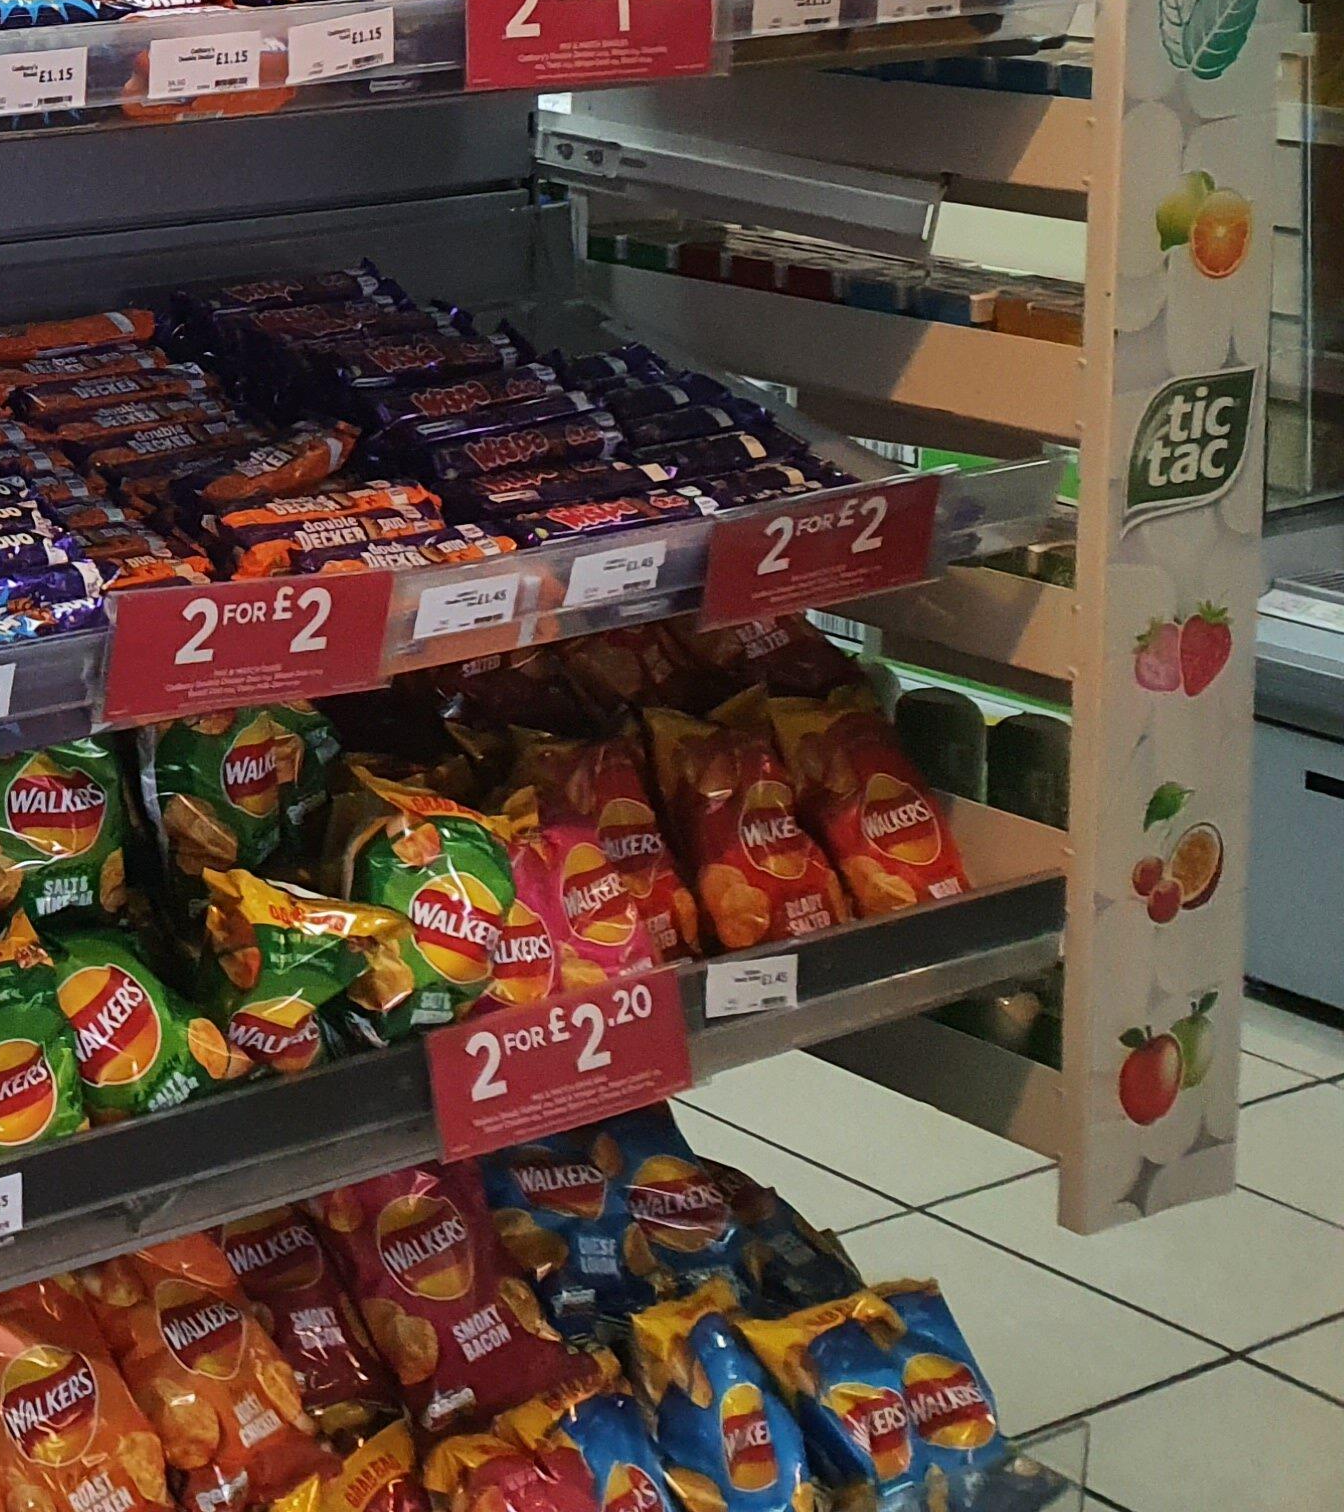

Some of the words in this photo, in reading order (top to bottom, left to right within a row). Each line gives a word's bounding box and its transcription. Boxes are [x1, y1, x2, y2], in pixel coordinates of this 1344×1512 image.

[351, 27, 382, 45] £1.15
[39, 68, 73, 84] £1.15
[215, 49, 249, 67] £1.15
[1166, 386, 1236, 444] tic
[1146, 437, 1229, 488] tac
[294, 526, 367, 552] DECKER
[303, 515, 359, 534] double
[756, 515, 794, 575] 2
[794, 513, 833, 537] FOR
[836, 495, 888, 554] £2
[174, 597, 219, 665] 2
[222, 600, 267, 627] FOR
[271, 585, 332, 654] £2
[10, 780, 107, 814] WALKERS
[863, 800, 932, 841] WALKERS
[465, 1031, 508, 1102] 2
[504, 1025, 548, 1057] FOR
[547, 983, 652, 1074] £2.20
[515, 1163, 603, 1193] WALKERS
[227, 1224, 313, 1276] WALKERS
[384, 1216, 466, 1272] WALKERS
[164, 1301, 240, 1351] WALKERS
[452, 1303, 502, 1344] SMOKY
[461, 1322, 512, 1363] BACON
[6, 1368, 94, 1439] WALKERS
